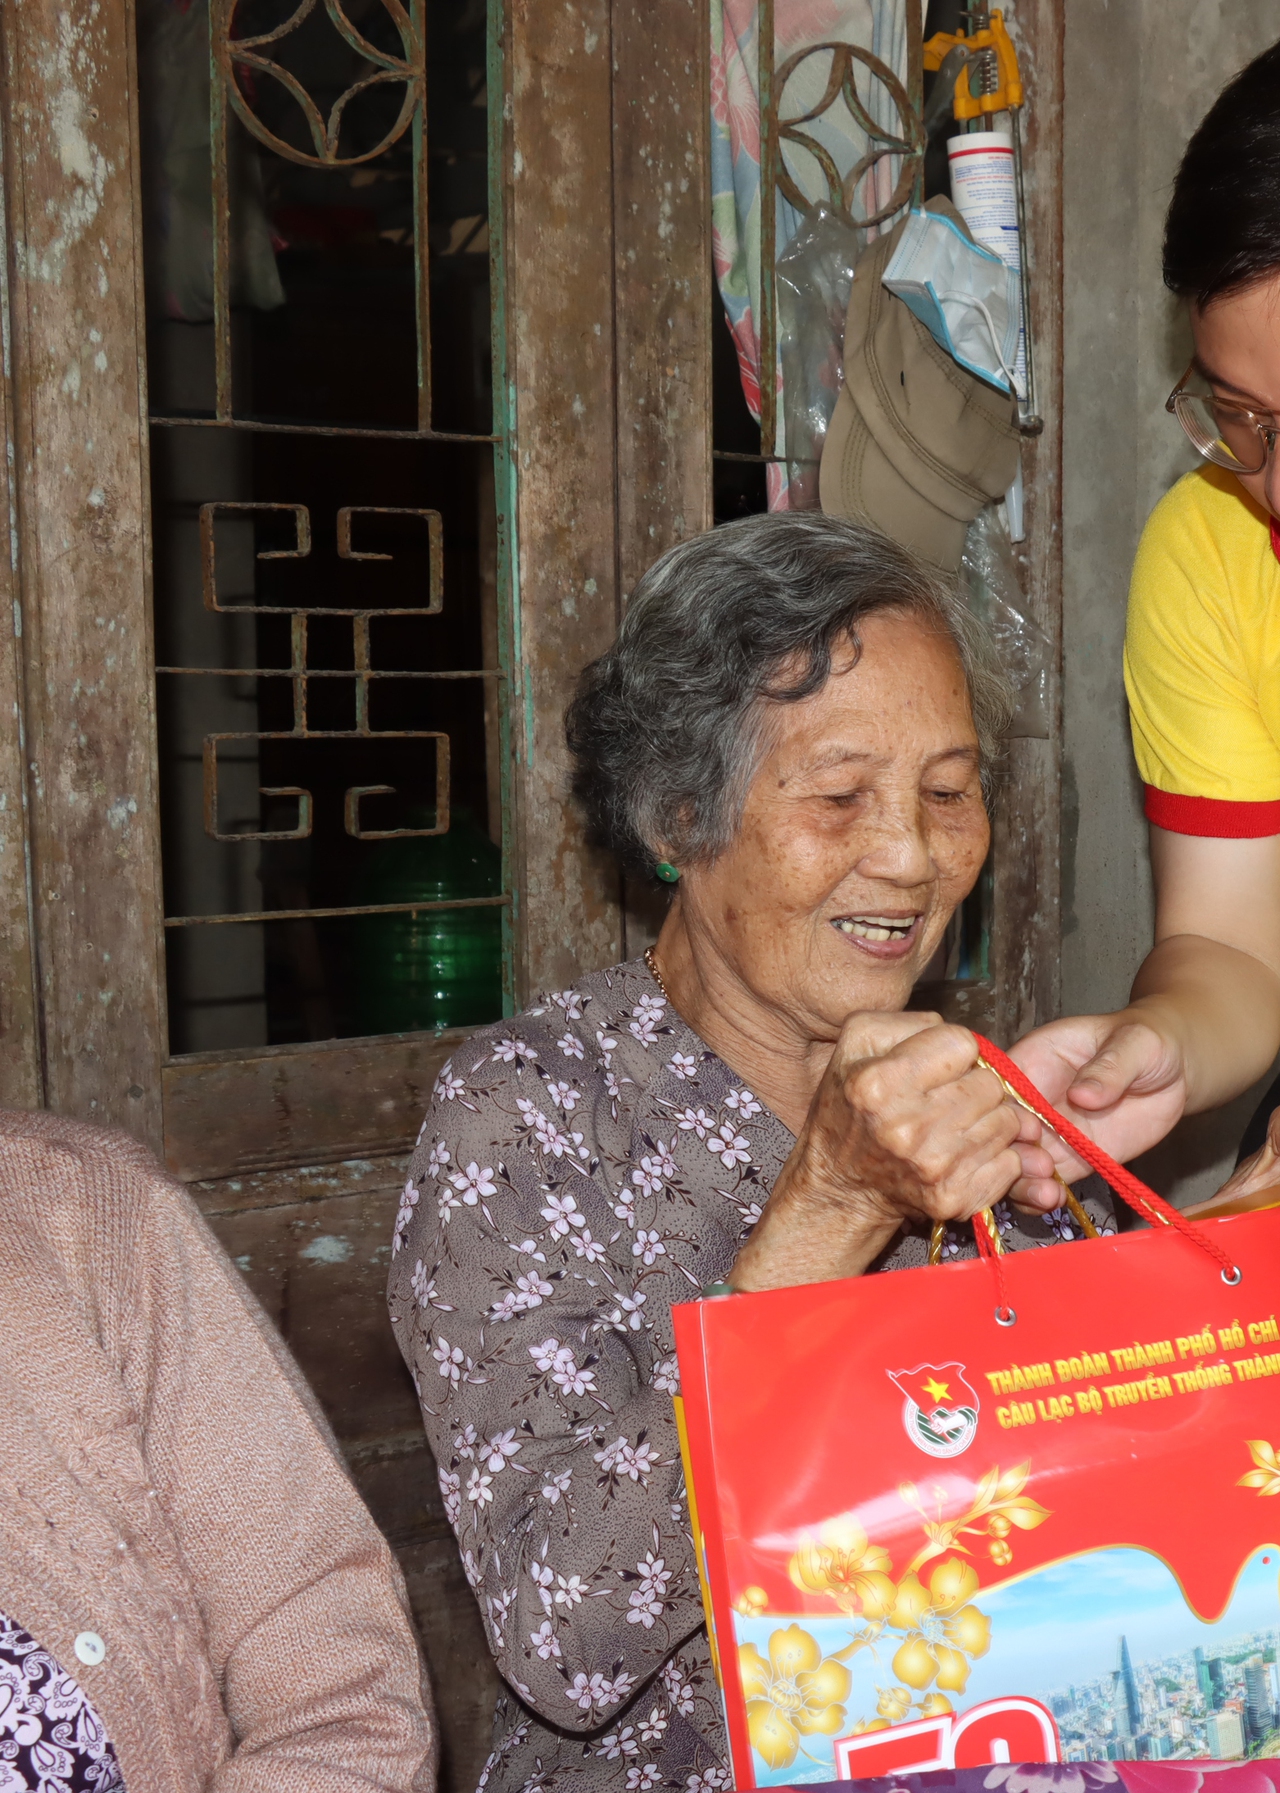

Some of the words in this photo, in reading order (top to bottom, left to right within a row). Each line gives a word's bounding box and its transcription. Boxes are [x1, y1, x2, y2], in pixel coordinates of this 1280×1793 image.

[984, 1363, 1055, 1396] THÀNH
[1054, 1350, 1112, 1383] ĐOÀN
[1109, 1341, 1176, 1373] THÀNH
[1175, 1323, 1217, 1360] PHỐ
[1217, 1318, 1246, 1351] HỒ
[1247, 1315, 1280, 1345] CHÍ
[995, 1400, 1037, 1430] CÂU
[1035, 1394, 1075, 1424] LẠC
[1074, 1384, 1104, 1415] BỘ
[1102, 1371, 1174, 1408] TRUYỀN
[1171, 1360, 1234, 1394] THỐNG
